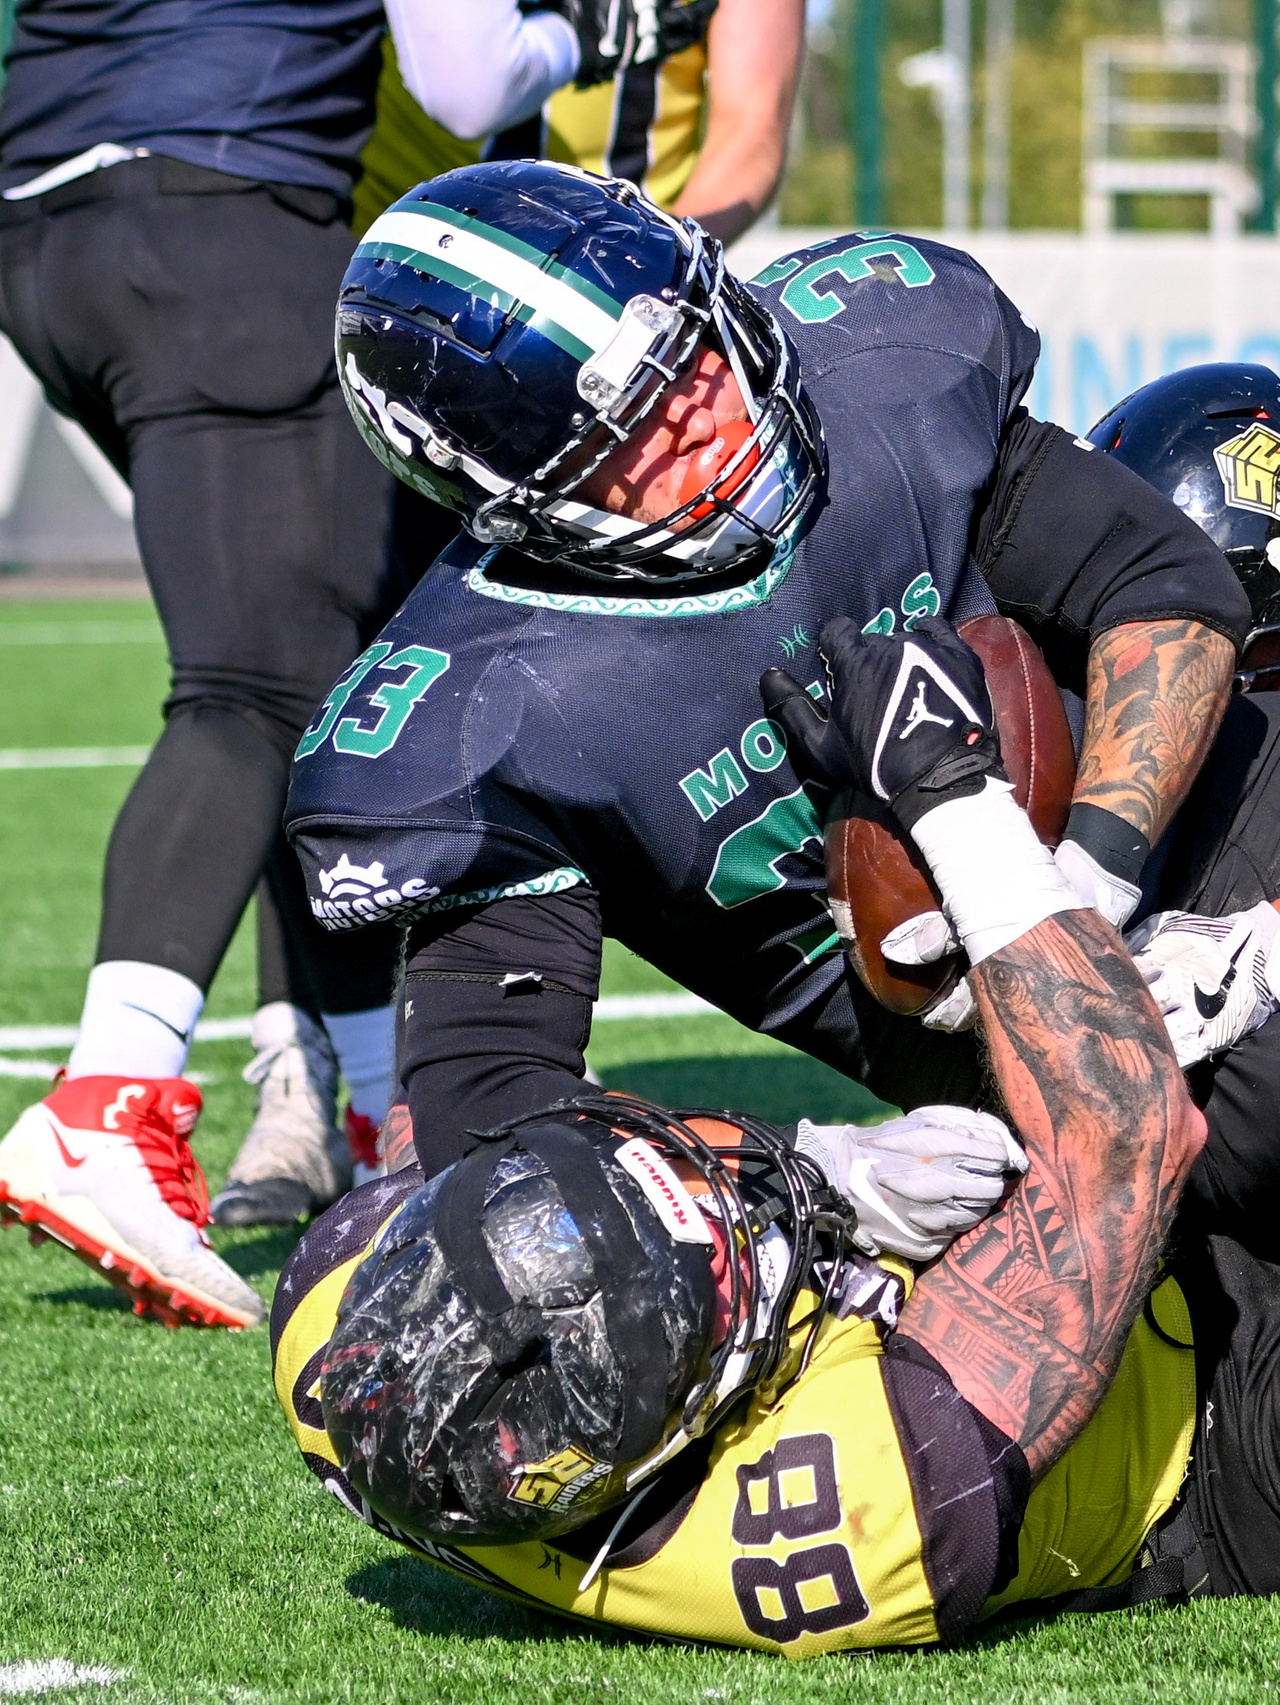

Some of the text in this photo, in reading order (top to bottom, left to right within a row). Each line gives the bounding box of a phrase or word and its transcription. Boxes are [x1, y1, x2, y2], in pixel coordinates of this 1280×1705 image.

[294, 641, 451, 763] 33
[548, 1463, 614, 1514] RAIDERS
[731, 1432, 871, 1645] 88
